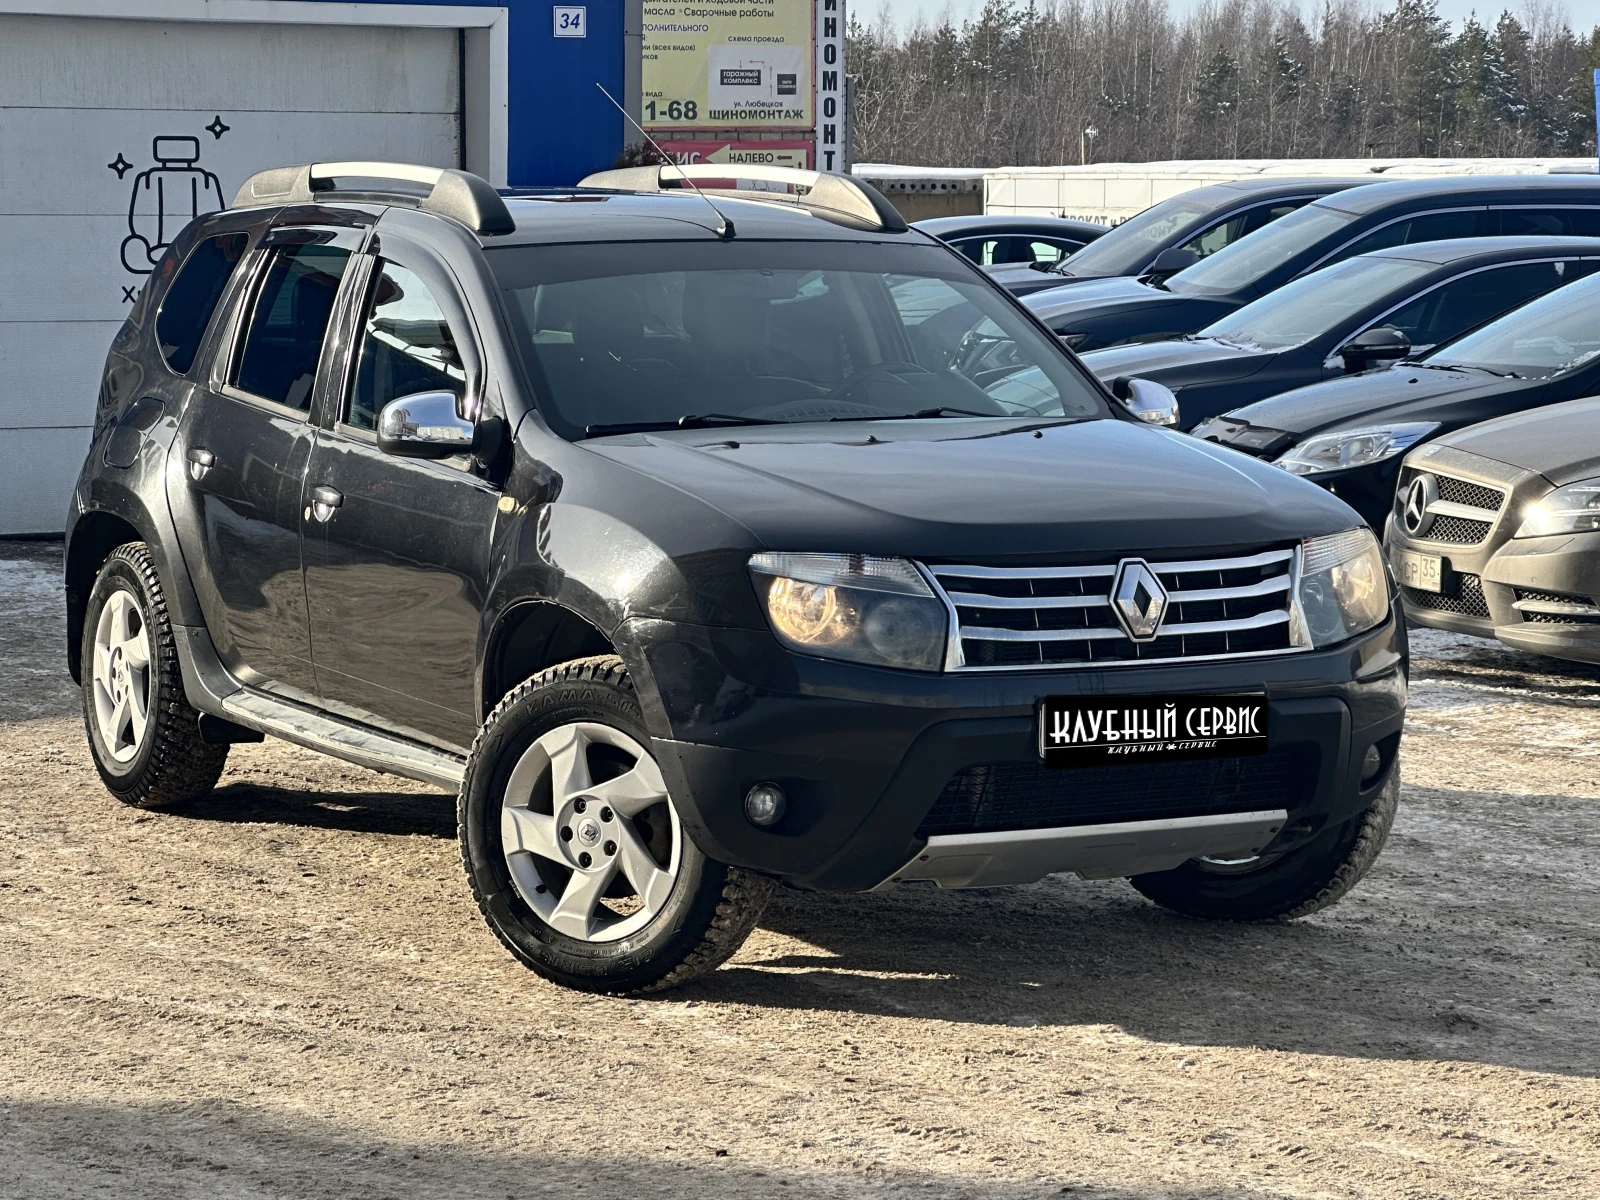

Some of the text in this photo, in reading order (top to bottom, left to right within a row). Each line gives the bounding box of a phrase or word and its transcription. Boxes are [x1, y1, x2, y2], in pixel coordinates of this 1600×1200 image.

[644, 7, 774, 19] масла Сварочные работы
[560, 13, 580, 29] 34
[728, 35, 785, 44] схема проезда
[723, 70, 759, 78] гаражный
[645, 100, 698, 121] 1-68
[709, 109, 804, 120] ШИНОМОНТАЖ
[728, 152, 774, 164] НАЛЕВО
[1422, 558, 1436, 578] 35
